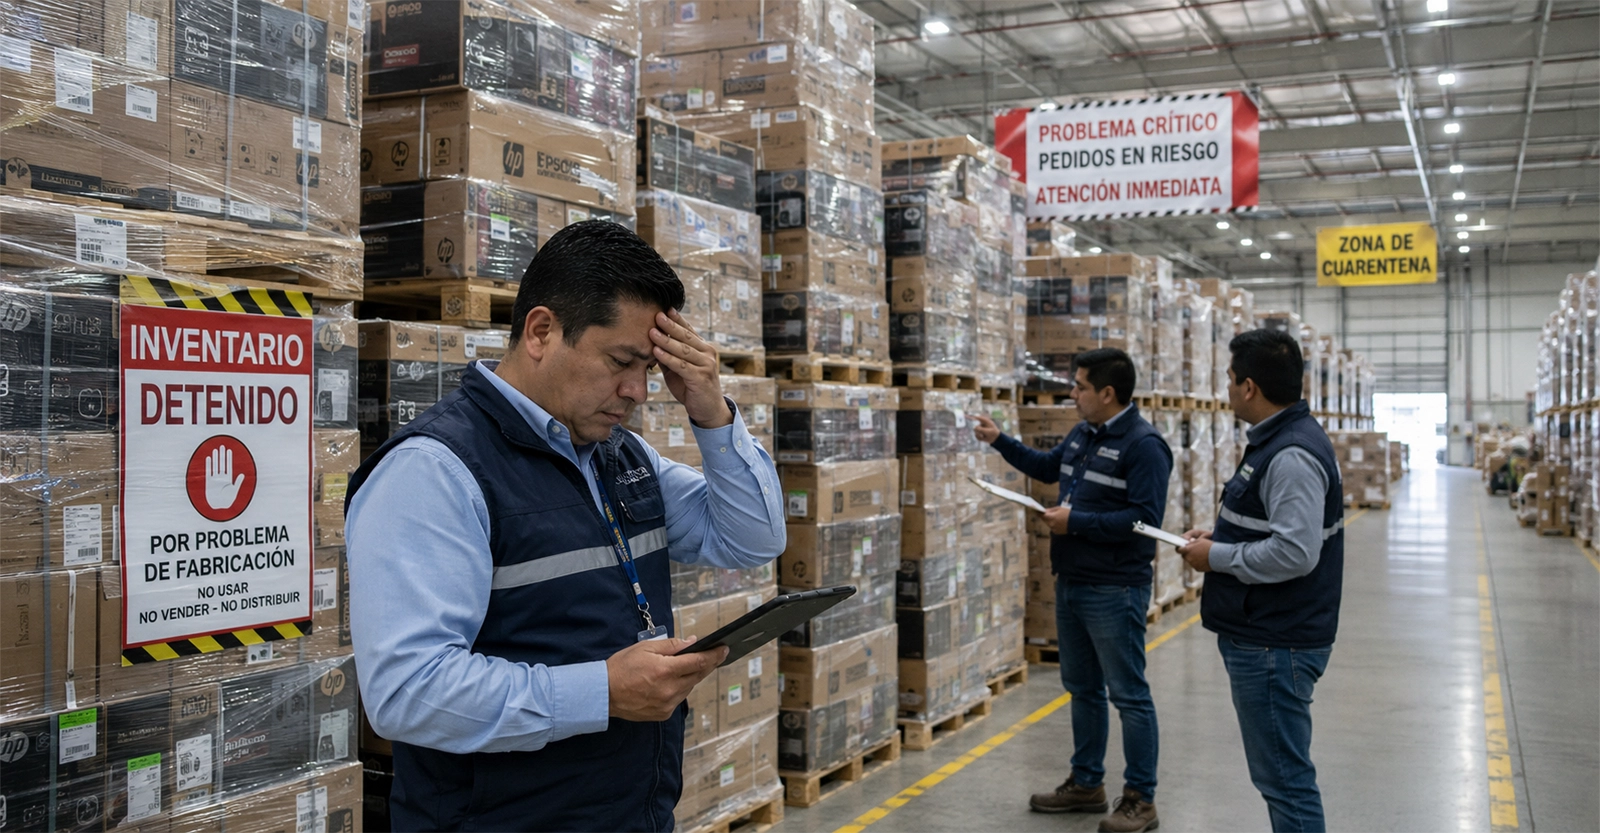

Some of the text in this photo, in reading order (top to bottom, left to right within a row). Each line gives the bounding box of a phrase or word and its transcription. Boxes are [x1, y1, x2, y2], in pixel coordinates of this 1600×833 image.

[1039, 110, 1218, 143] PROBLEMA CRÍTICO
[505, 142, 523, 176] hp
[1039, 141, 1219, 171] PEDIDOS EN RIESGO
[1035, 176, 1222, 205] ATENCIÓN INMEDIATA
[1339, 233, 1414, 253] ZONA DE
[1322, 256, 1431, 276] CUARENTENA
[131, 324, 304, 367] INVENTARIO
[141, 383, 298, 425] DETENIDO
[150, 525, 290, 555] POR PROBLEMA
[144, 546, 295, 582] DE FABRICACIÓN
[197, 582, 249, 599] NO USAR
[139, 610, 158, 624] NO
[161, 603, 210, 621] VENDER
[220, 599, 238, 613] NO
[240, 591, 301, 610] DISTRIBUIR
